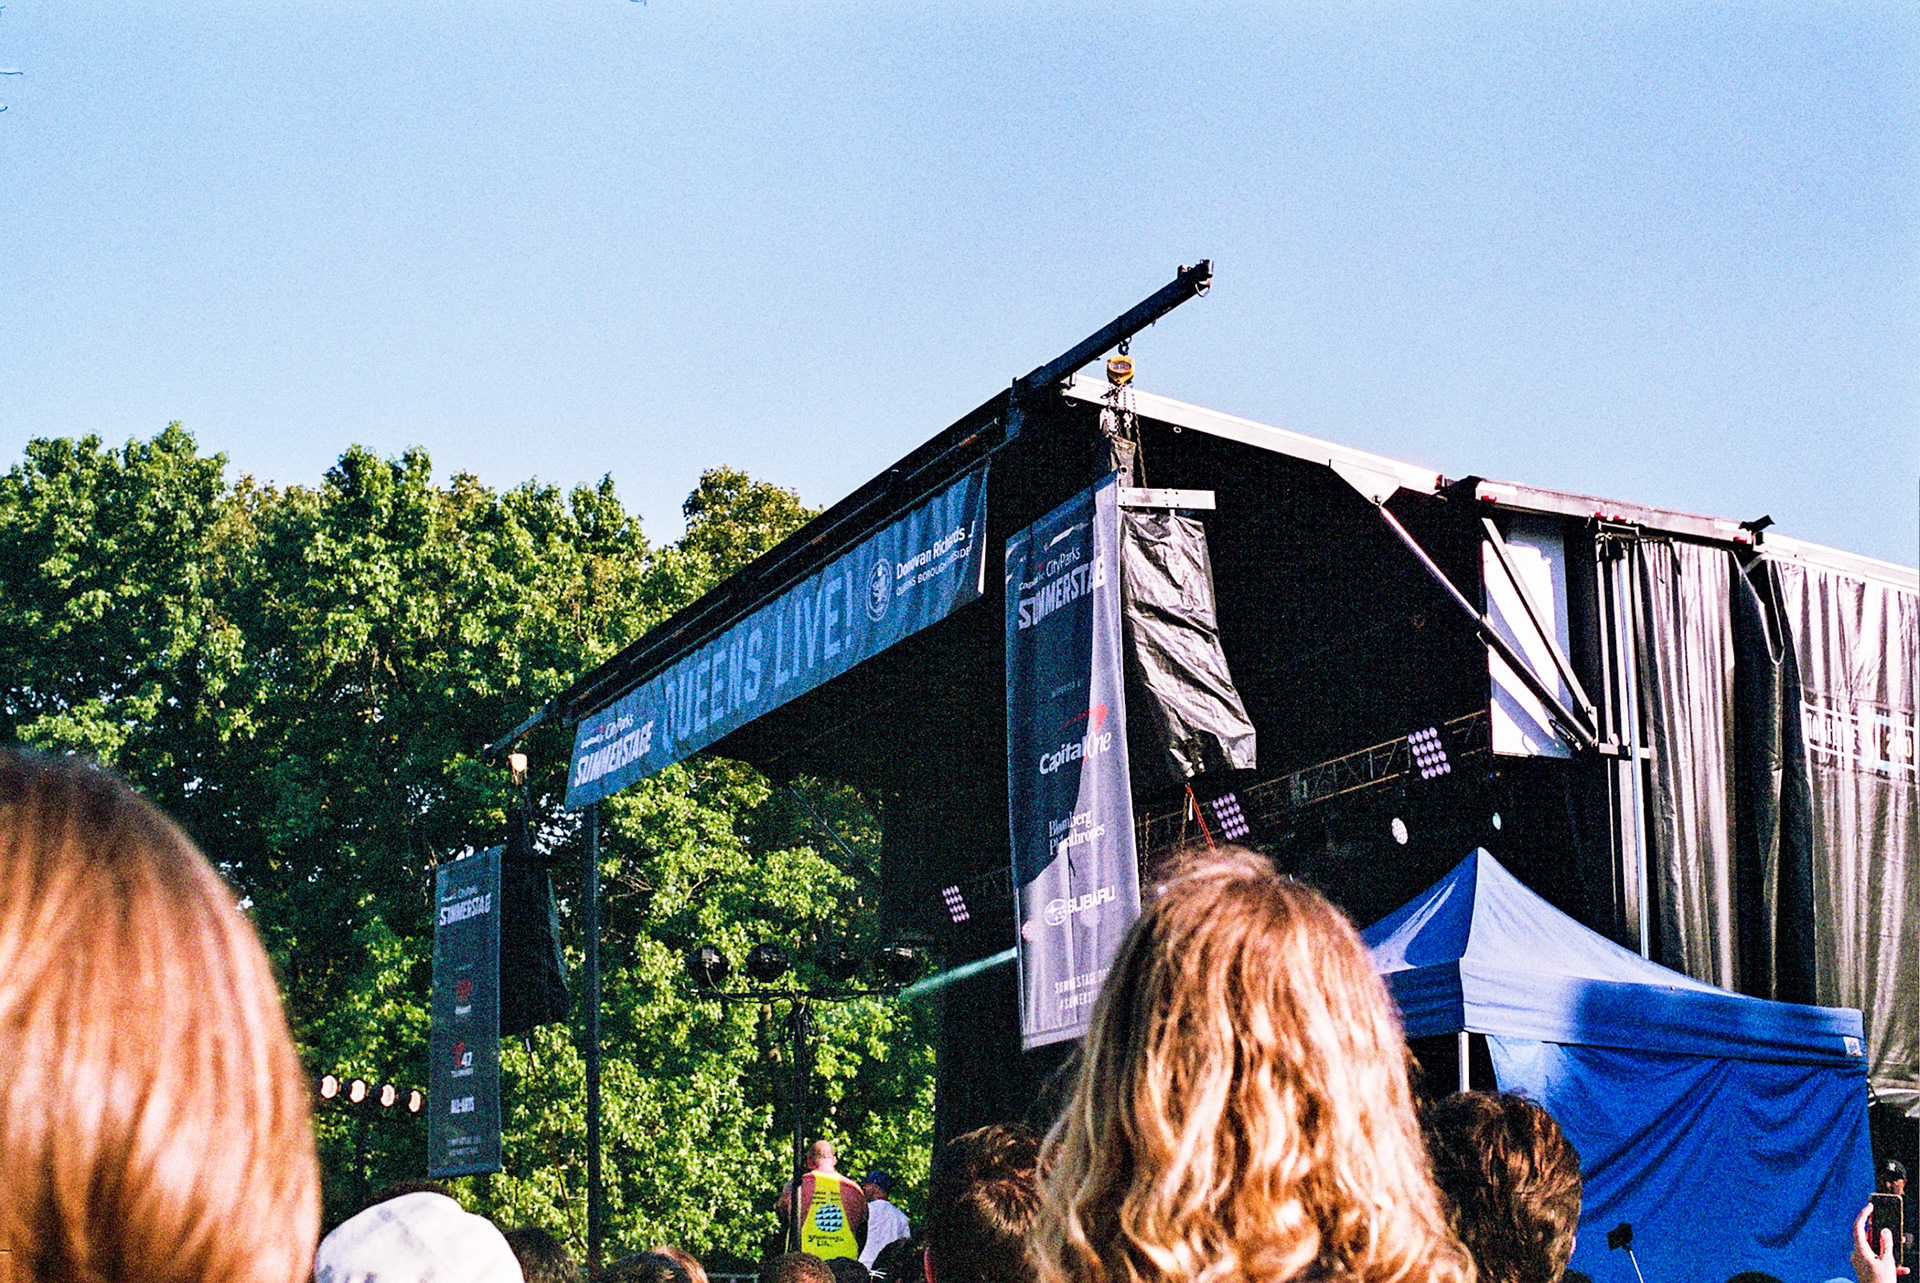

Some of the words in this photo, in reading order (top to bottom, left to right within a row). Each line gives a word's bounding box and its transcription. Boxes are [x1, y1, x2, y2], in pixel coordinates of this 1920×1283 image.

[1046, 546, 1081, 577] CityParks
[663, 628, 763, 755] QUEENS
[774, 569, 853, 690] LIVE!
[1068, 885, 1116, 915] SUBARU
